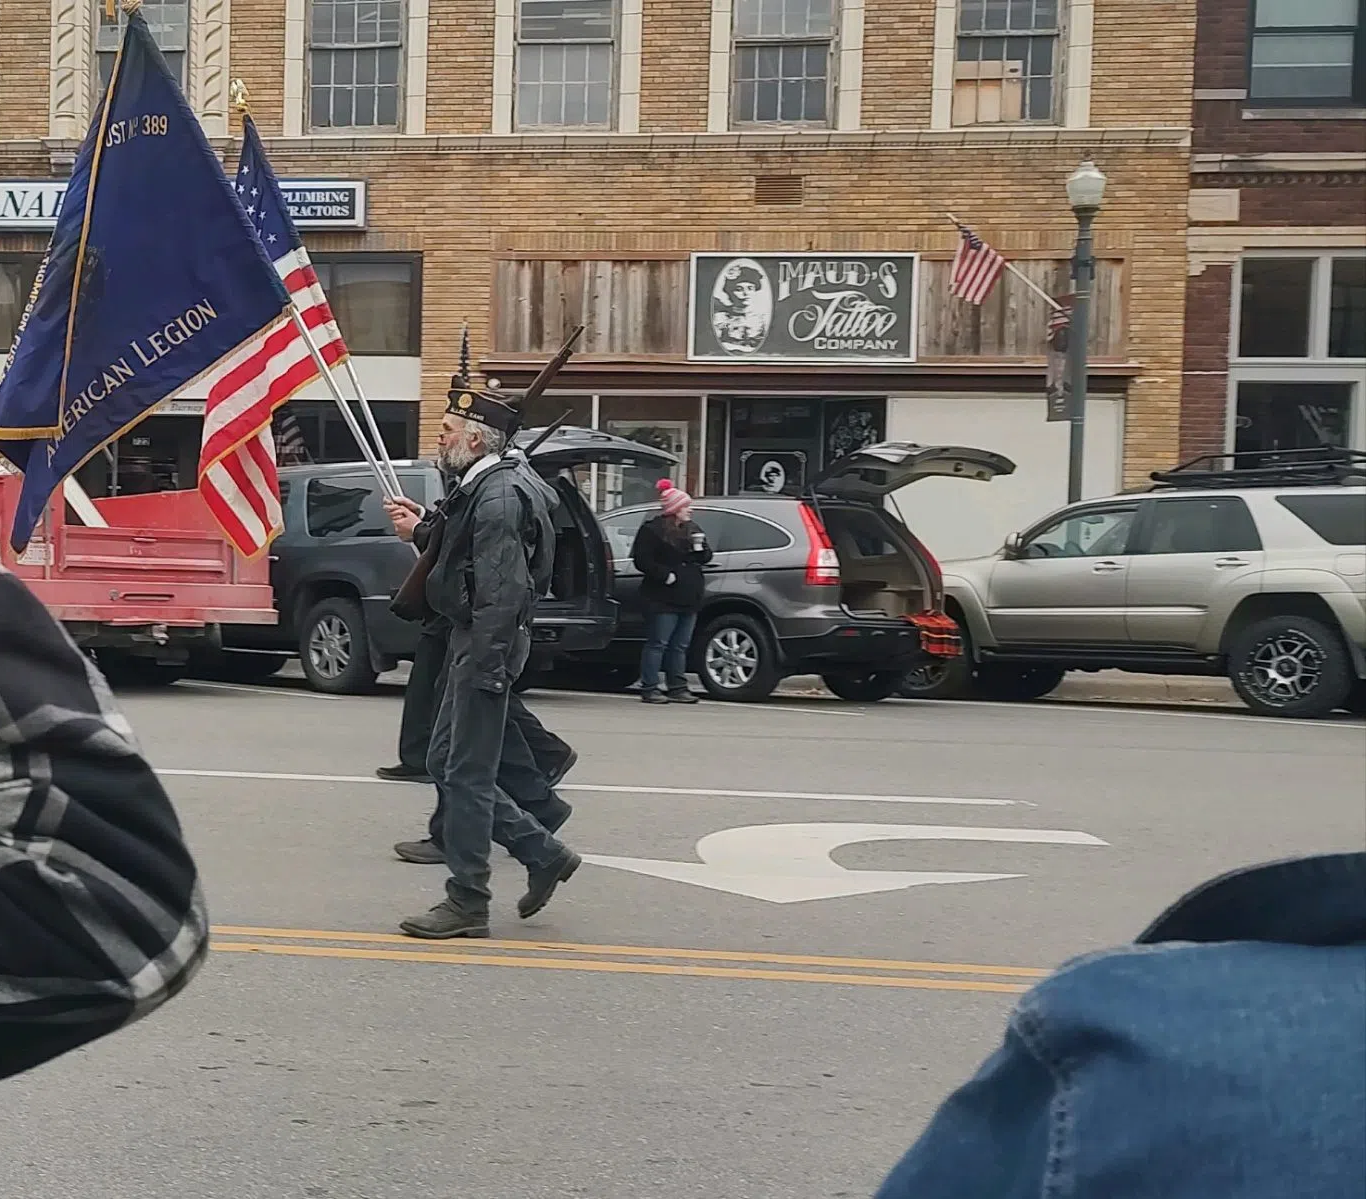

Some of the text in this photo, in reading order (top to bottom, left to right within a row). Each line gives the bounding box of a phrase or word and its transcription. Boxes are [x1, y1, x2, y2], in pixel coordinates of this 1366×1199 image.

[142, 114, 168, 136] 389
[18, 256, 50, 332] THOMPSON
[777, 260, 899, 302] MAUD'S
[129, 298, 218, 368] LEGION
[788, 290, 898, 342] Tattoo
[813, 337, 899, 350] COMPANY
